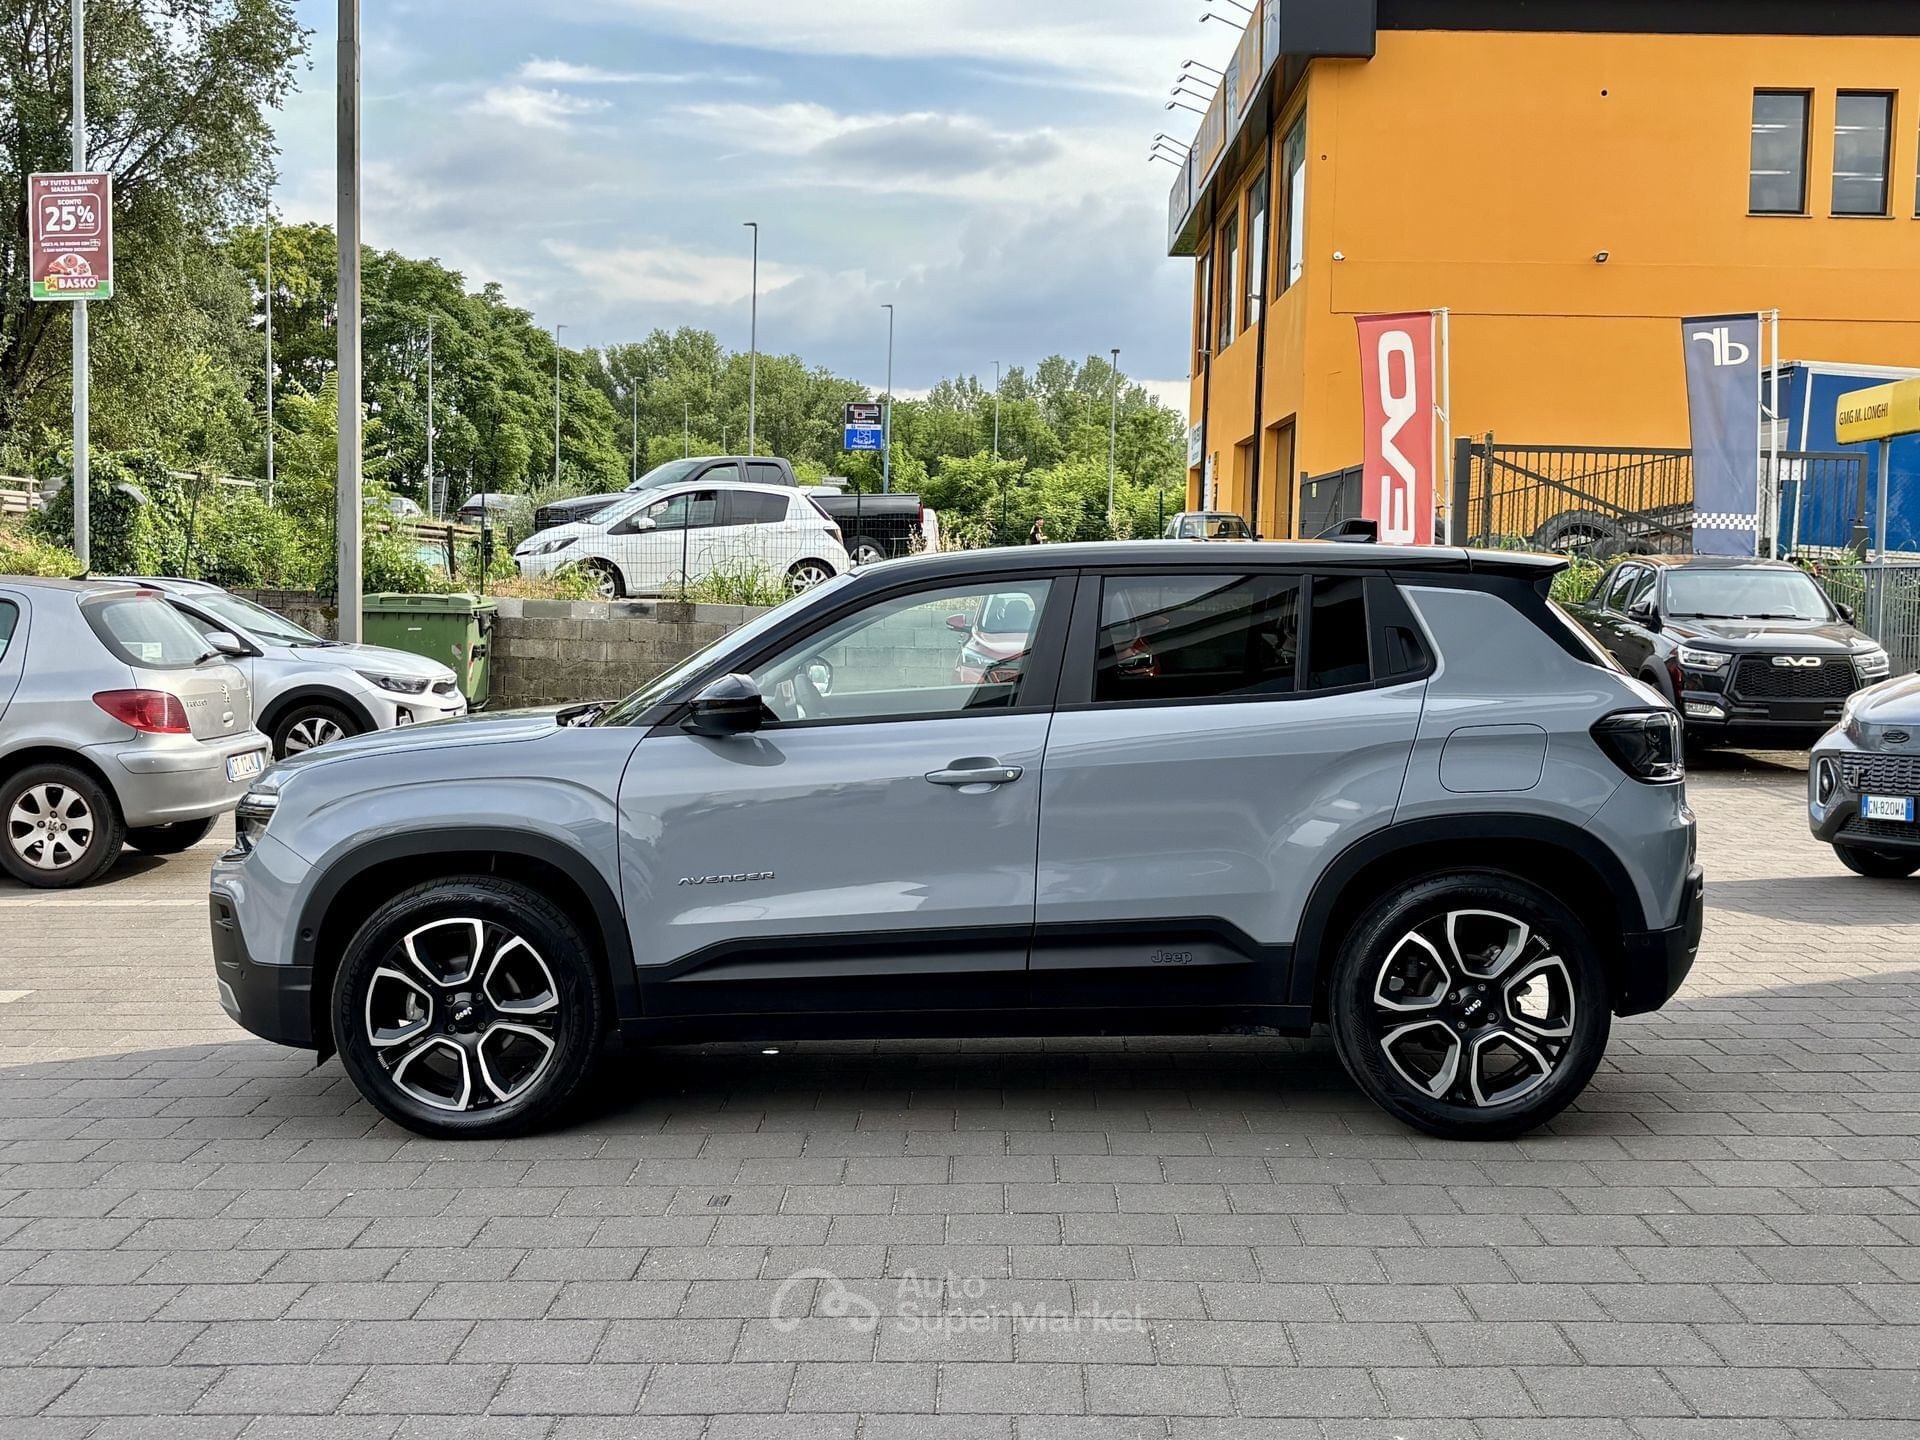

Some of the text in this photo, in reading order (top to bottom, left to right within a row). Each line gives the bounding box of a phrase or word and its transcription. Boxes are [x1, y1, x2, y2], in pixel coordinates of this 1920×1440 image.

[45, 205, 95, 232] 25%
[58, 278, 97, 289] BASKO
[1838, 409, 1854, 425] GMG
[1863, 402, 1889, 421] LONGHI
[1771, 656, 1822, 667] EVO
[678, 871, 775, 886] AVENGER
[1151, 949, 1193, 964] Jeep
